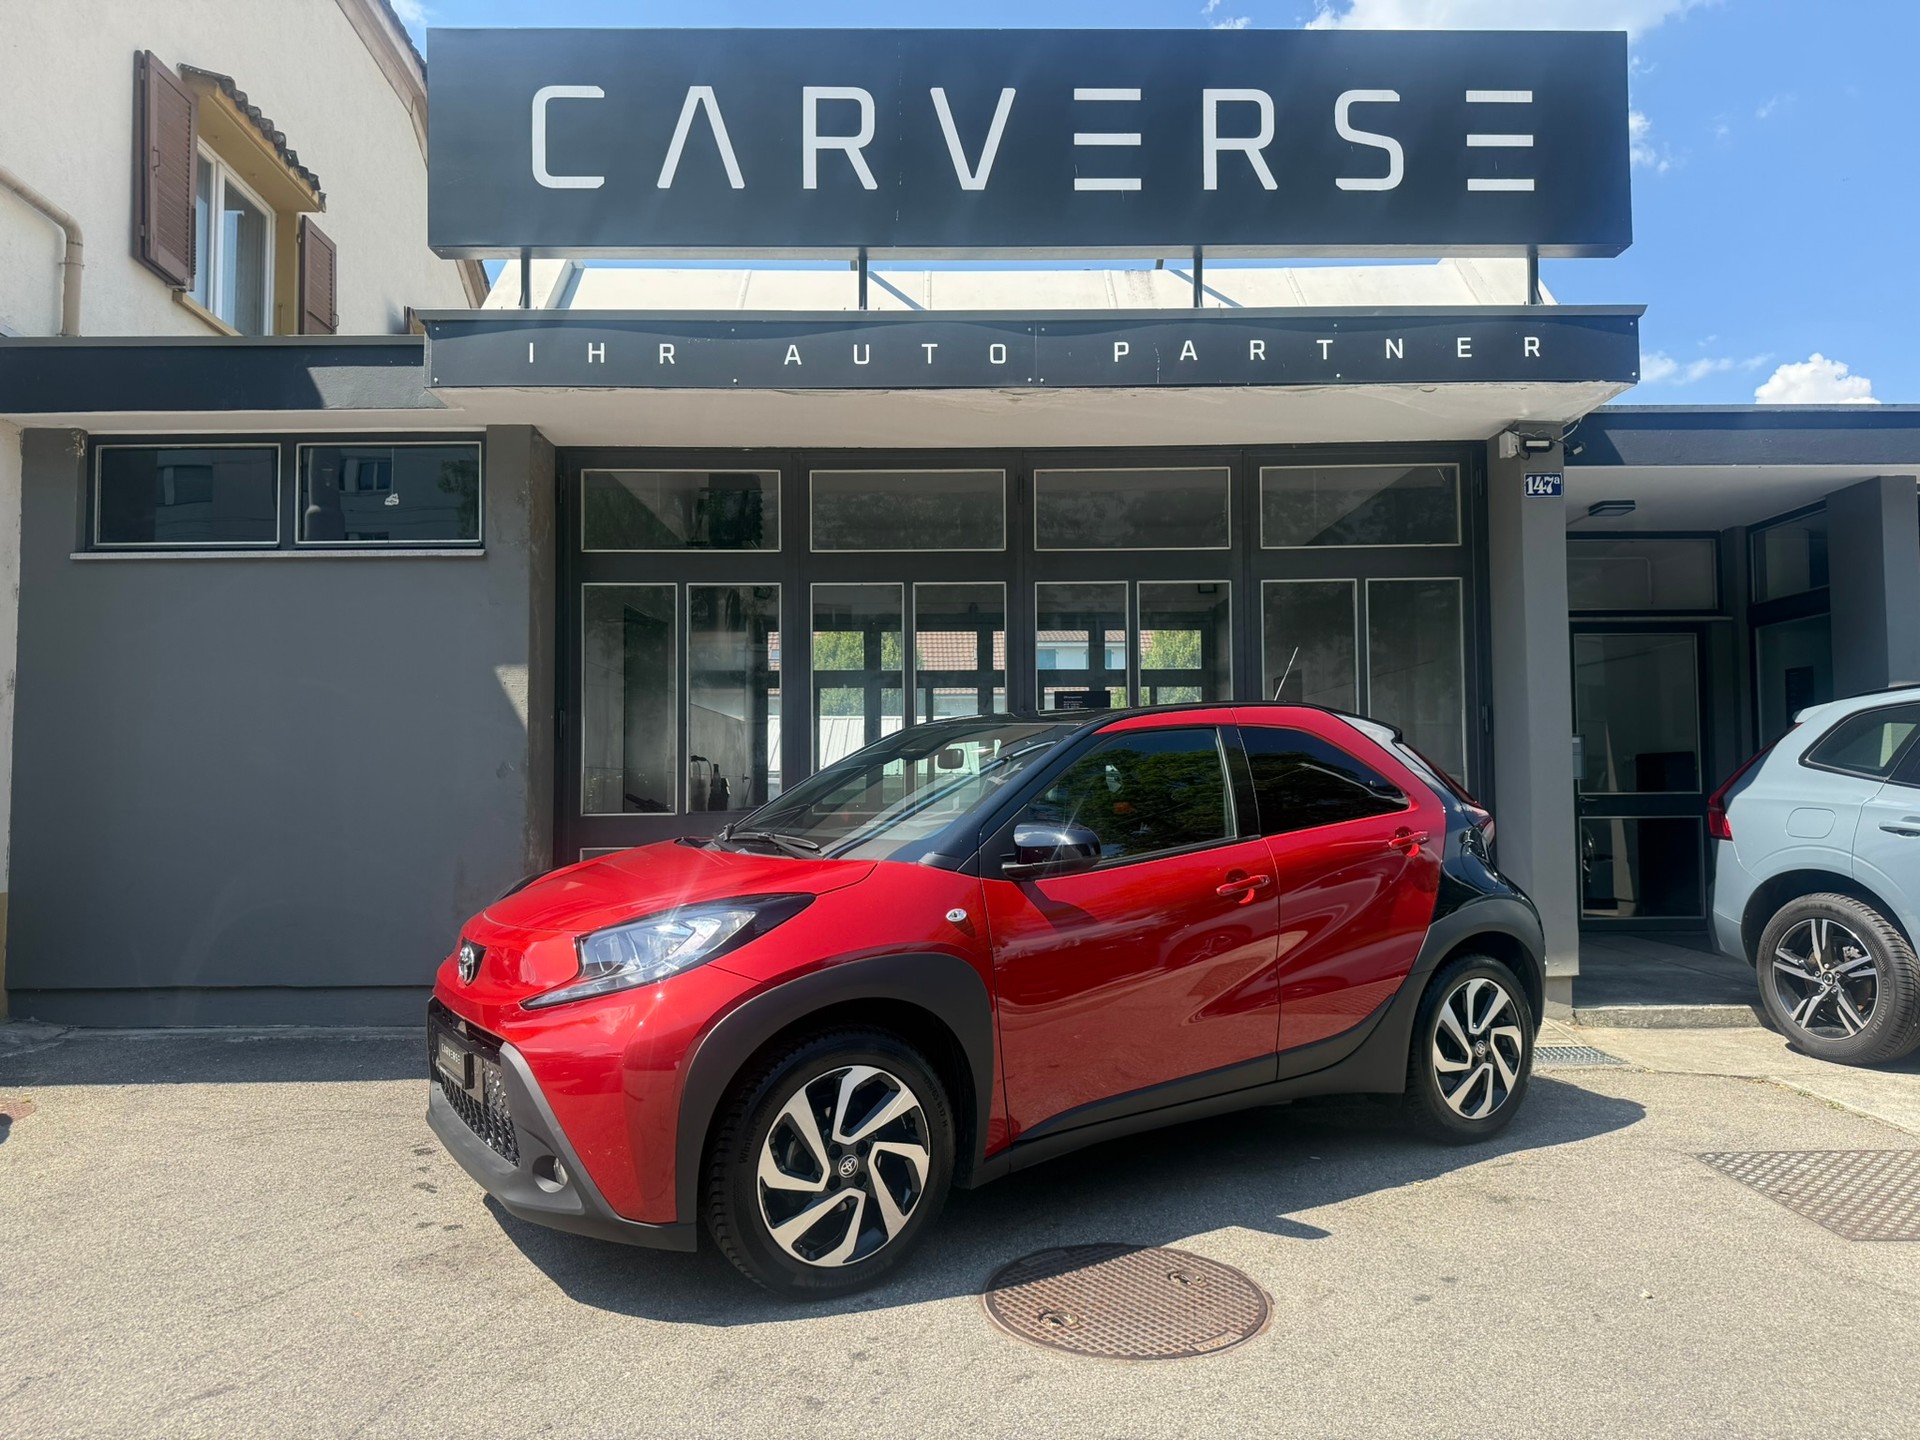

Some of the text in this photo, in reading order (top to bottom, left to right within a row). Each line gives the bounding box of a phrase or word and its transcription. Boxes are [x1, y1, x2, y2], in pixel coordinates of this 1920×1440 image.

[531, 84, 1535, 191] CARVERSE
[528, 336, 1541, 366] IHR AUTO PARTNER
[1526, 476, 1560, 494] 147a
[1871, 977, 1891, 1034] Continental
